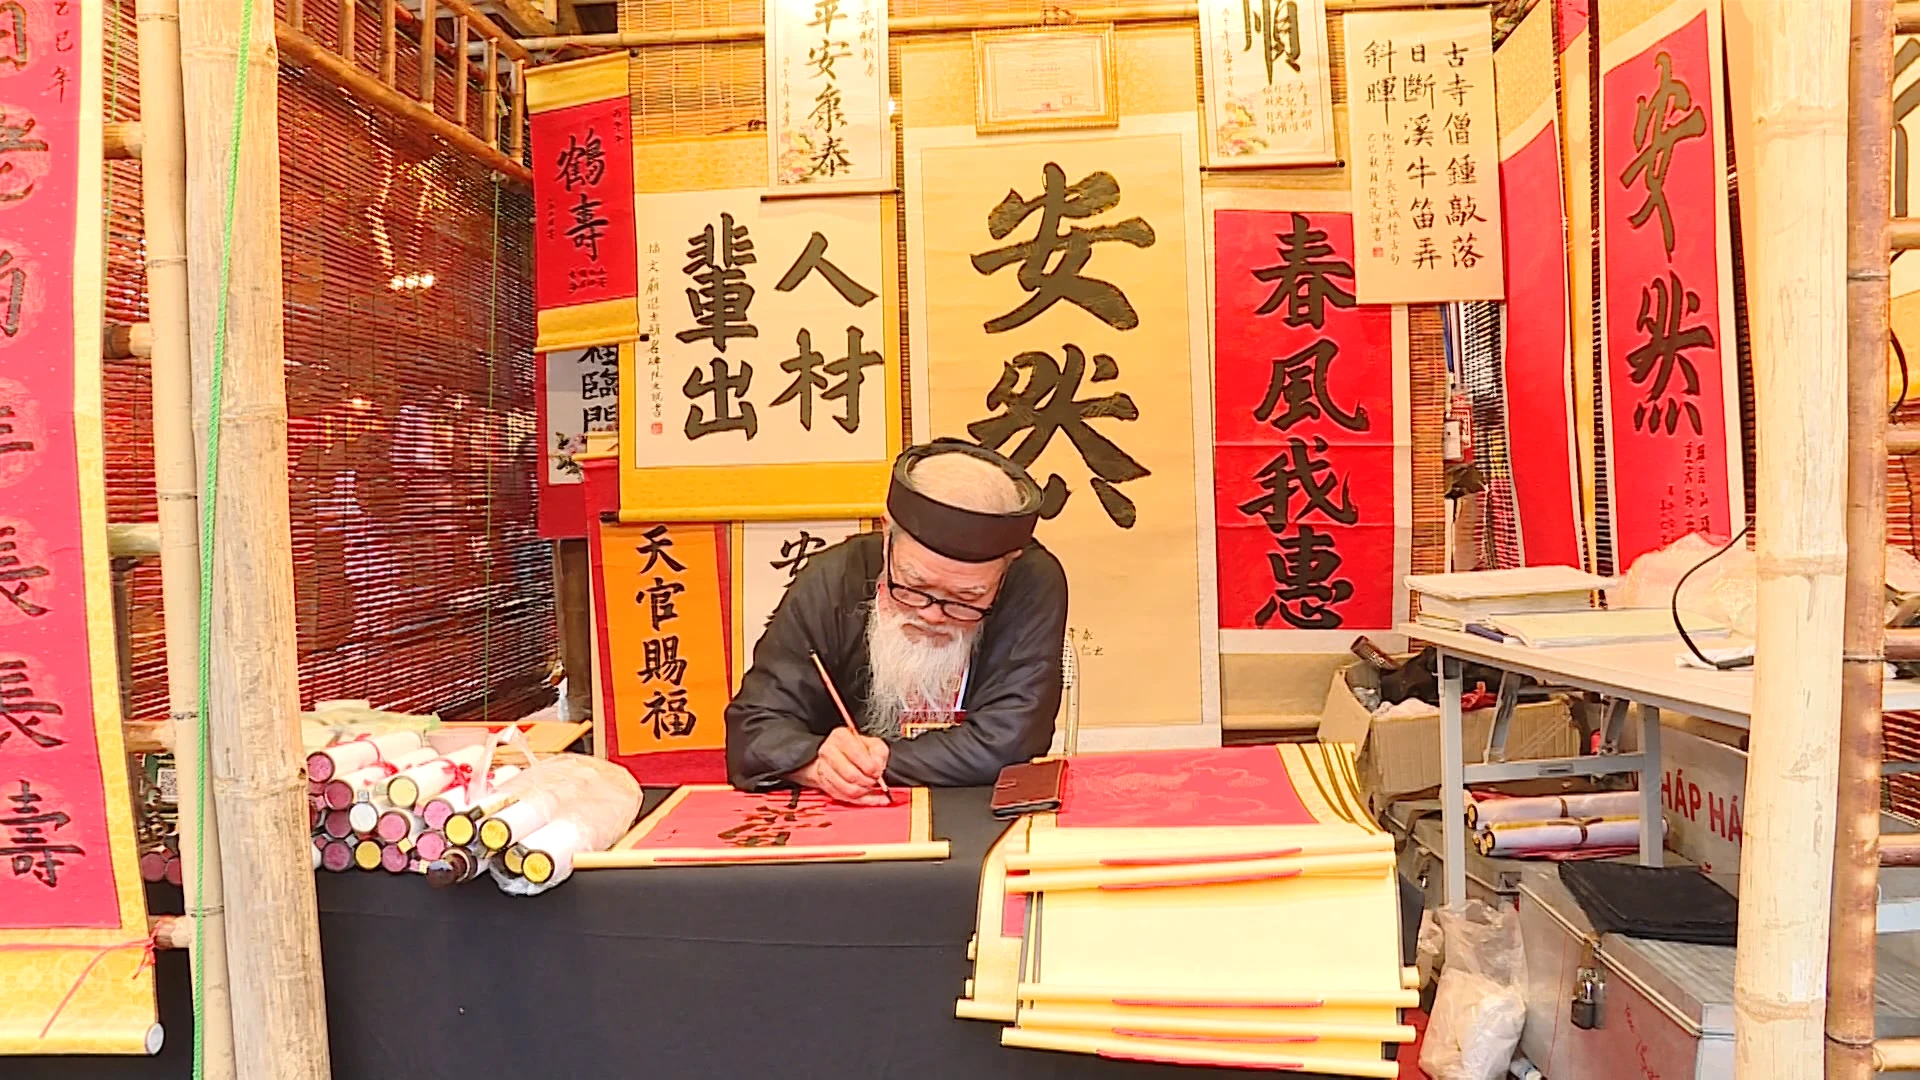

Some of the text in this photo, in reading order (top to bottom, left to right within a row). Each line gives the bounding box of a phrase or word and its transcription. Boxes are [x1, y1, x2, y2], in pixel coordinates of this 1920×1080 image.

[675, 212, 759, 441] 輩出
[769, 231, 884, 433] 人材
[635, 525, 697, 740] 天官賜福
[1662, 768, 1702, 821] HÁP
